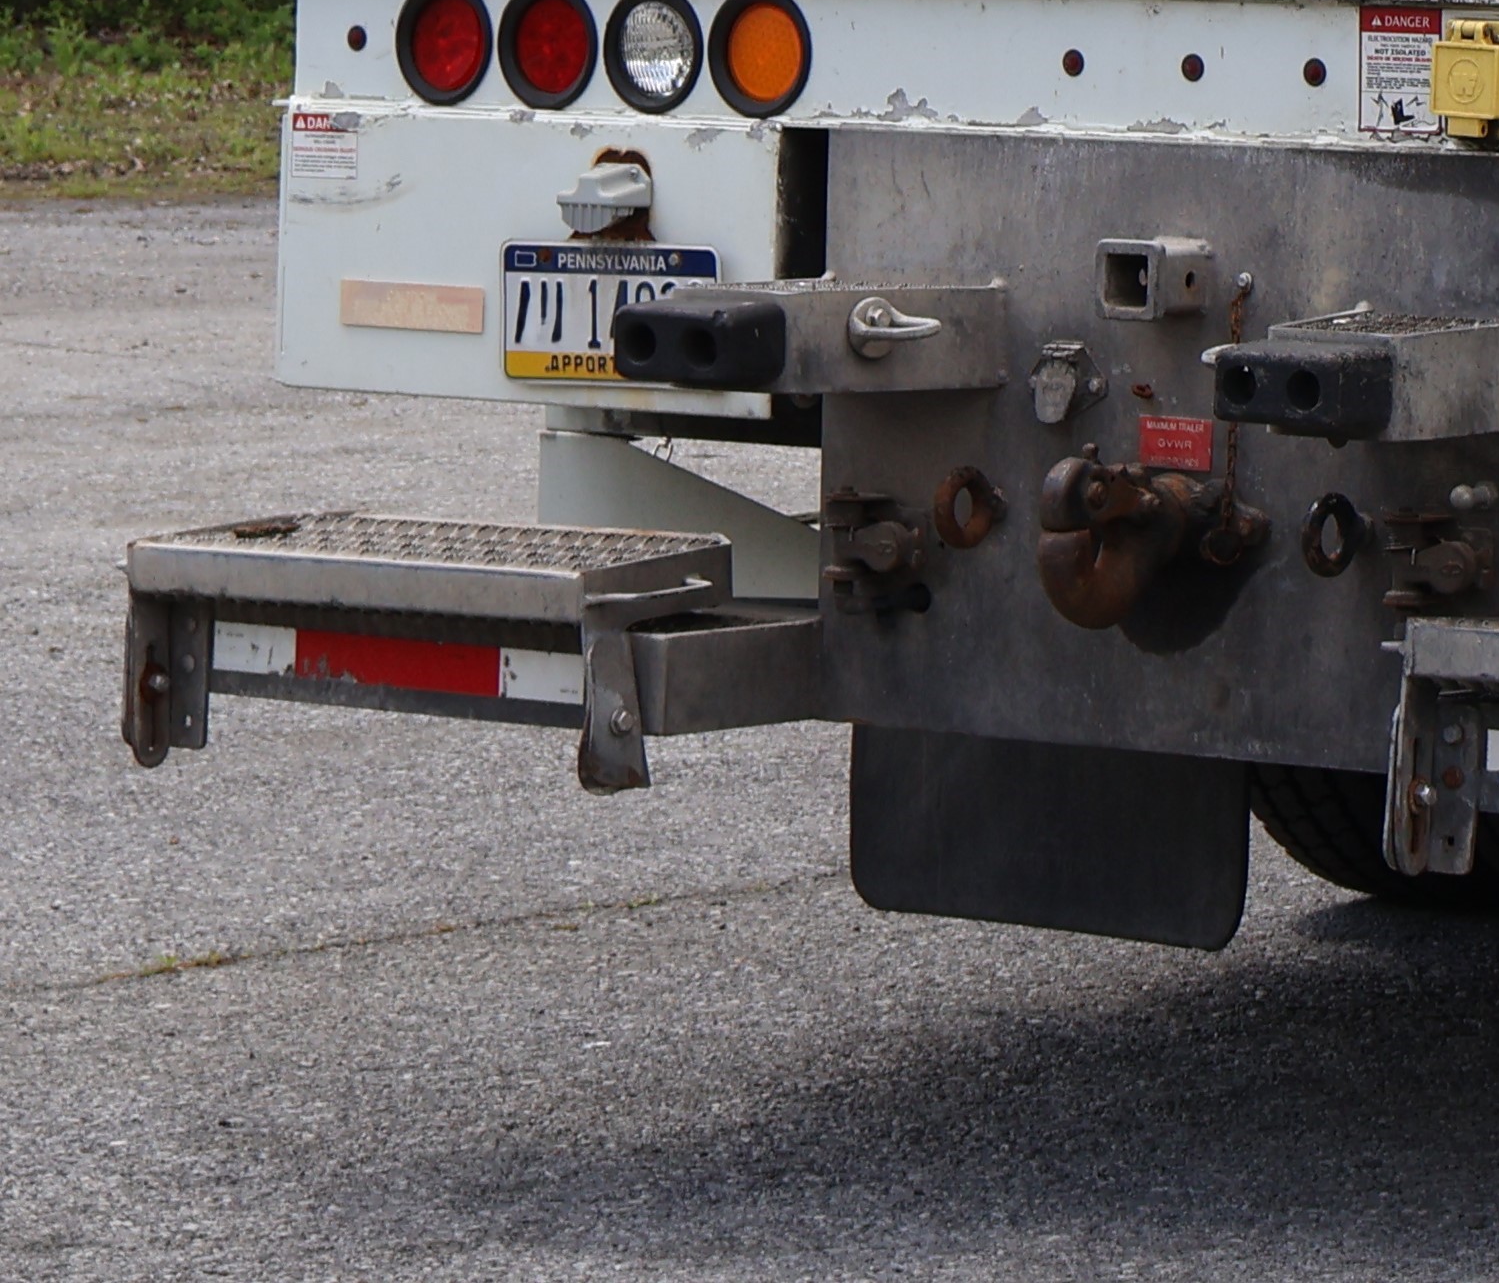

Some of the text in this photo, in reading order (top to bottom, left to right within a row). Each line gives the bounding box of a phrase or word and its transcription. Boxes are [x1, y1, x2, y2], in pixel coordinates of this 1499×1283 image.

[1385, 15, 1431, 28] DANGER
[1368, 35, 1410, 43] ELECTROCUTION
[1375, 48, 1427, 57] NOT ISOLATED
[558, 253, 667, 272] PENNSYLVANIA
[1146, 420, 1204, 434] MAXIMUM TRAILER
[1158, 438, 1192, 450] GVWR
